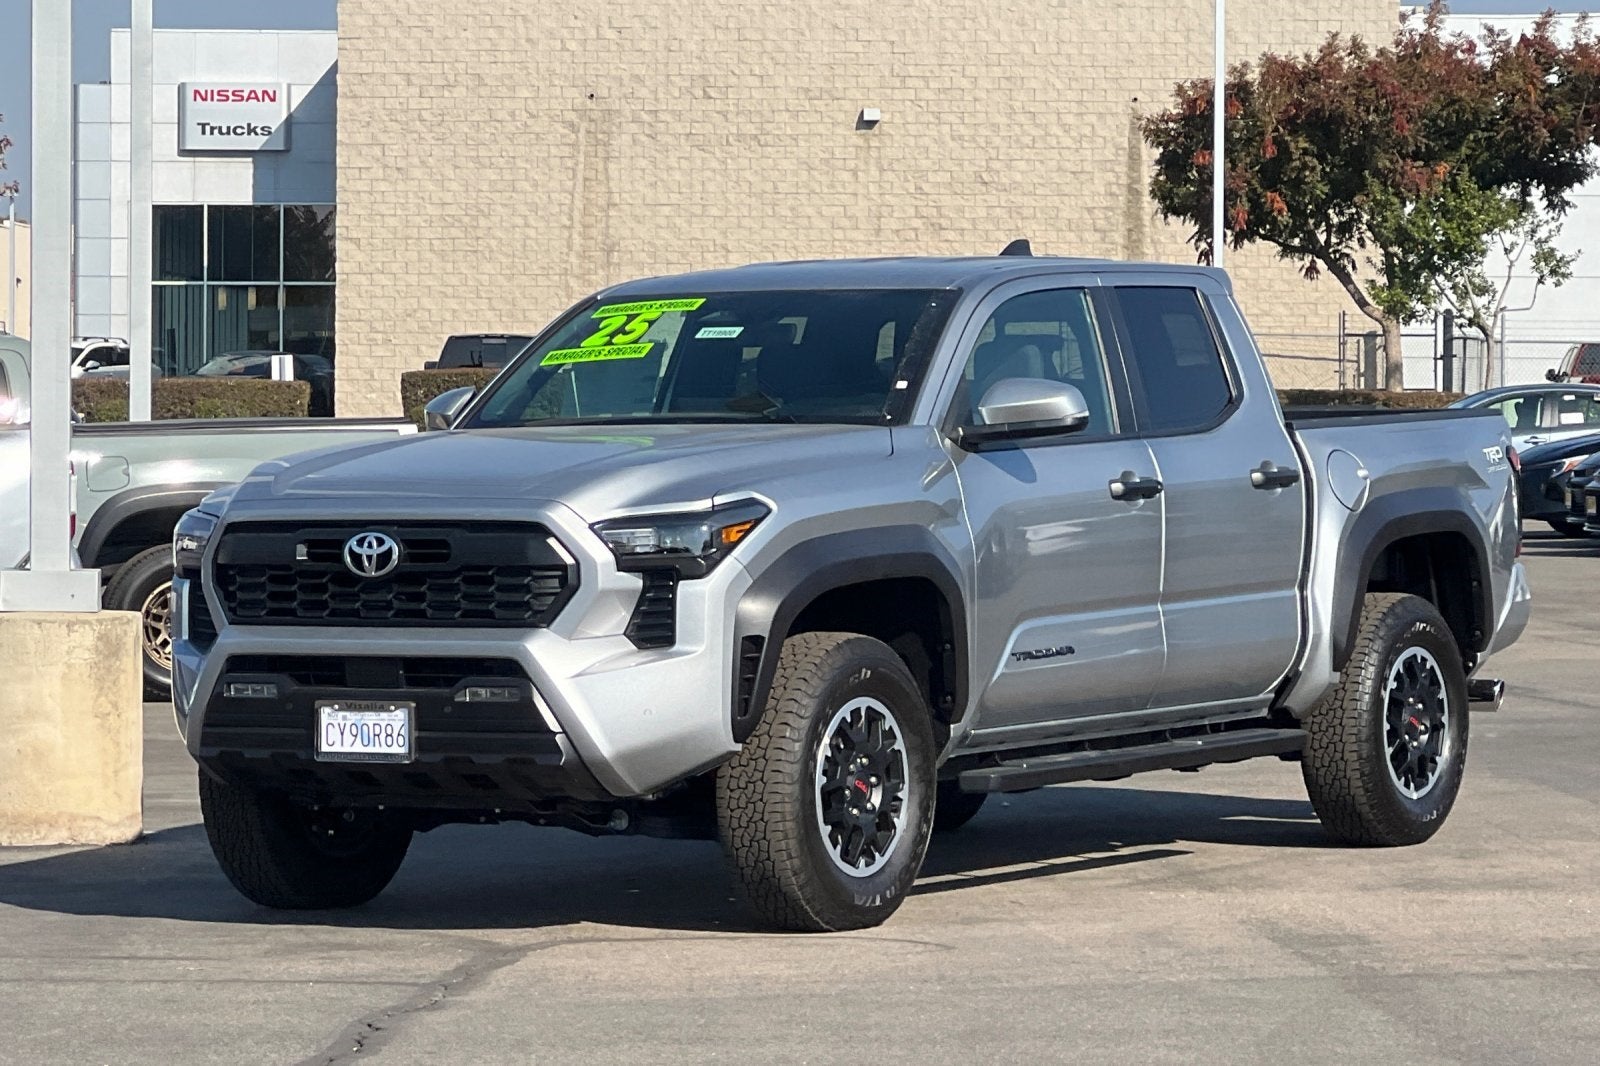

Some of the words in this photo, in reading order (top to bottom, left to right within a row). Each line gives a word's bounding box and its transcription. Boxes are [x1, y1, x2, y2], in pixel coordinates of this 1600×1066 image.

[193, 89, 277, 103] NISSAN
[196, 122, 273, 137] Trucks
[655, 300, 699, 311] SPECIAL
[580, 311, 663, 347] 25
[544, 349, 605, 363] MANAGER'S
[603, 345, 647, 358] SPECIAL
[1481, 446, 1503, 464] TRD
[1011, 646, 1075, 661] TACOMA
[325, 722, 406, 748] CY90R86
